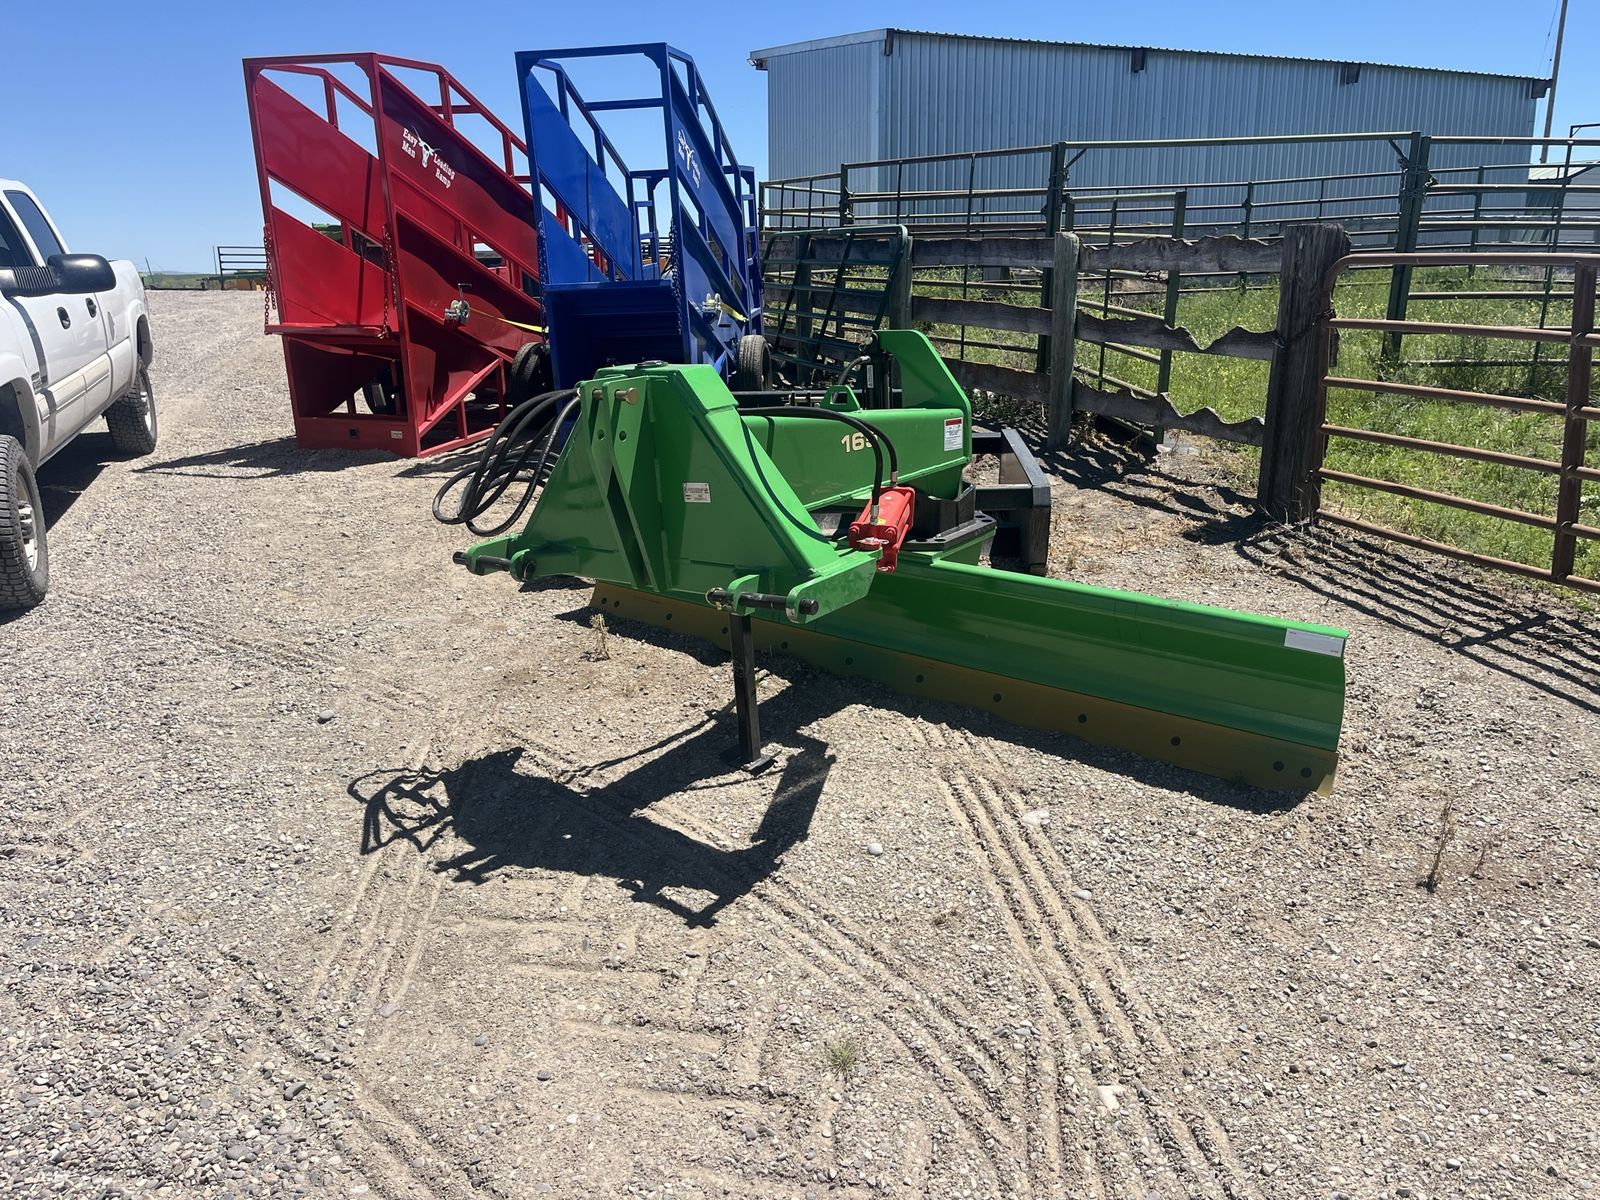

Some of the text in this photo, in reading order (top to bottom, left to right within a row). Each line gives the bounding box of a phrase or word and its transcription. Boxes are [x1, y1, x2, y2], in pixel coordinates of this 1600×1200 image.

[403, 127, 418, 147] Easy
[402, 140, 416, 158] Man
[433, 153, 456, 180] Loading
[435, 168, 451, 188] Ramp
